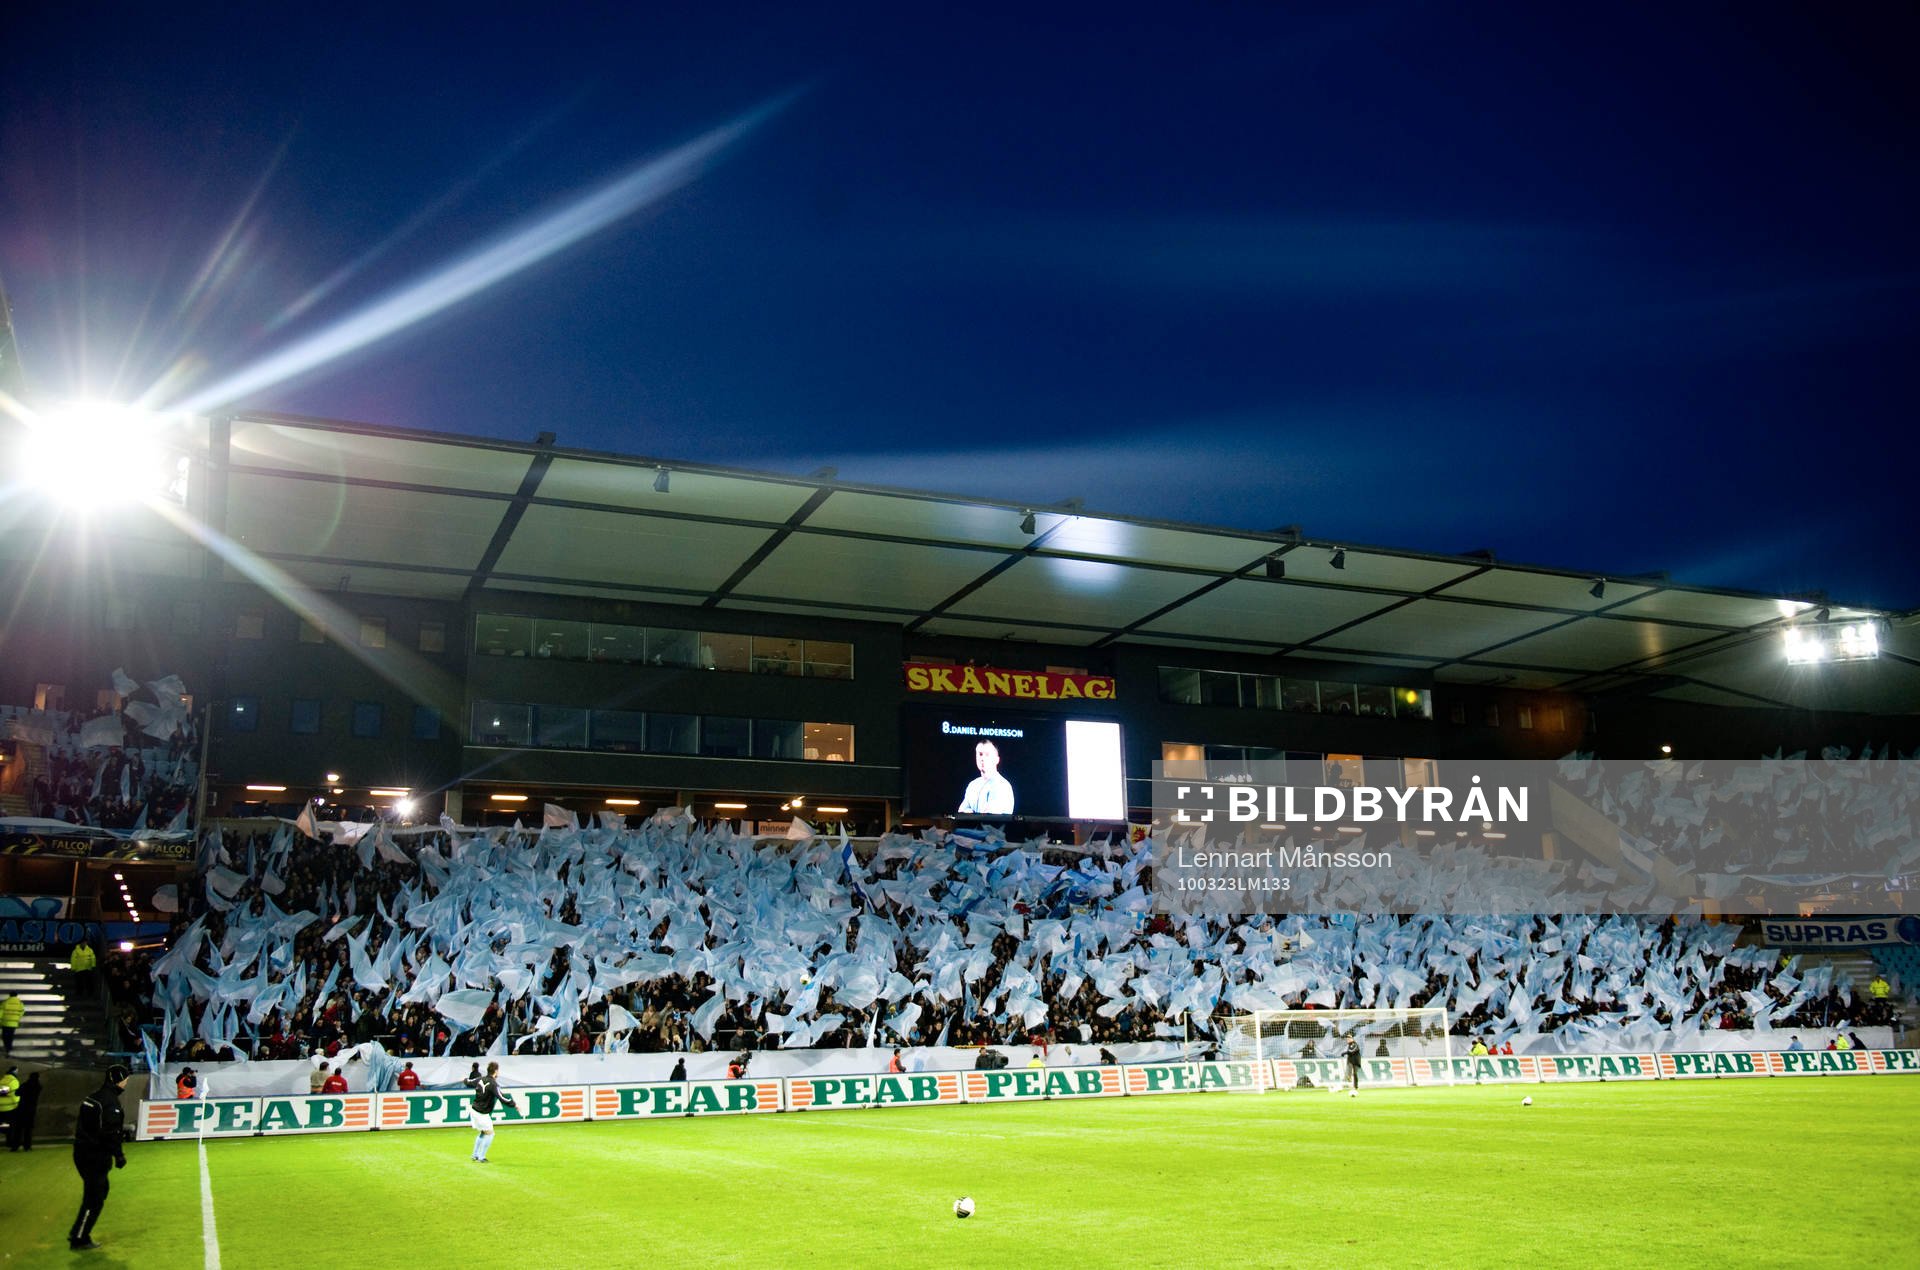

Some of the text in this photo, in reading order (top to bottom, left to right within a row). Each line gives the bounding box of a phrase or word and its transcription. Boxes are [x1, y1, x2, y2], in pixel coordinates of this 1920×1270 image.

[979, 727, 1024, 738] ANDERSSON
[51, 839, 92, 851] FALCON
[150, 843, 191, 855] FALCON
[0, 919, 103, 945] ASION
[1766, 922, 1888, 943] SUPRAS
[1428, 1057, 1522, 1081] PEAB
[1555, 1056, 1643, 1077] PEAB
[1674, 1052, 1755, 1074] PEAB
[1781, 1051, 1858, 1072] PEAB
[1881, 1050, 1920, 1070] PE
[985, 1069, 1104, 1097] PEAB
[1143, 1063, 1253, 1091] PEAB
[616, 1085, 759, 1116] PEAB
[810, 1076, 941, 1106] PEAB
[172, 1098, 345, 1133] PEAB
